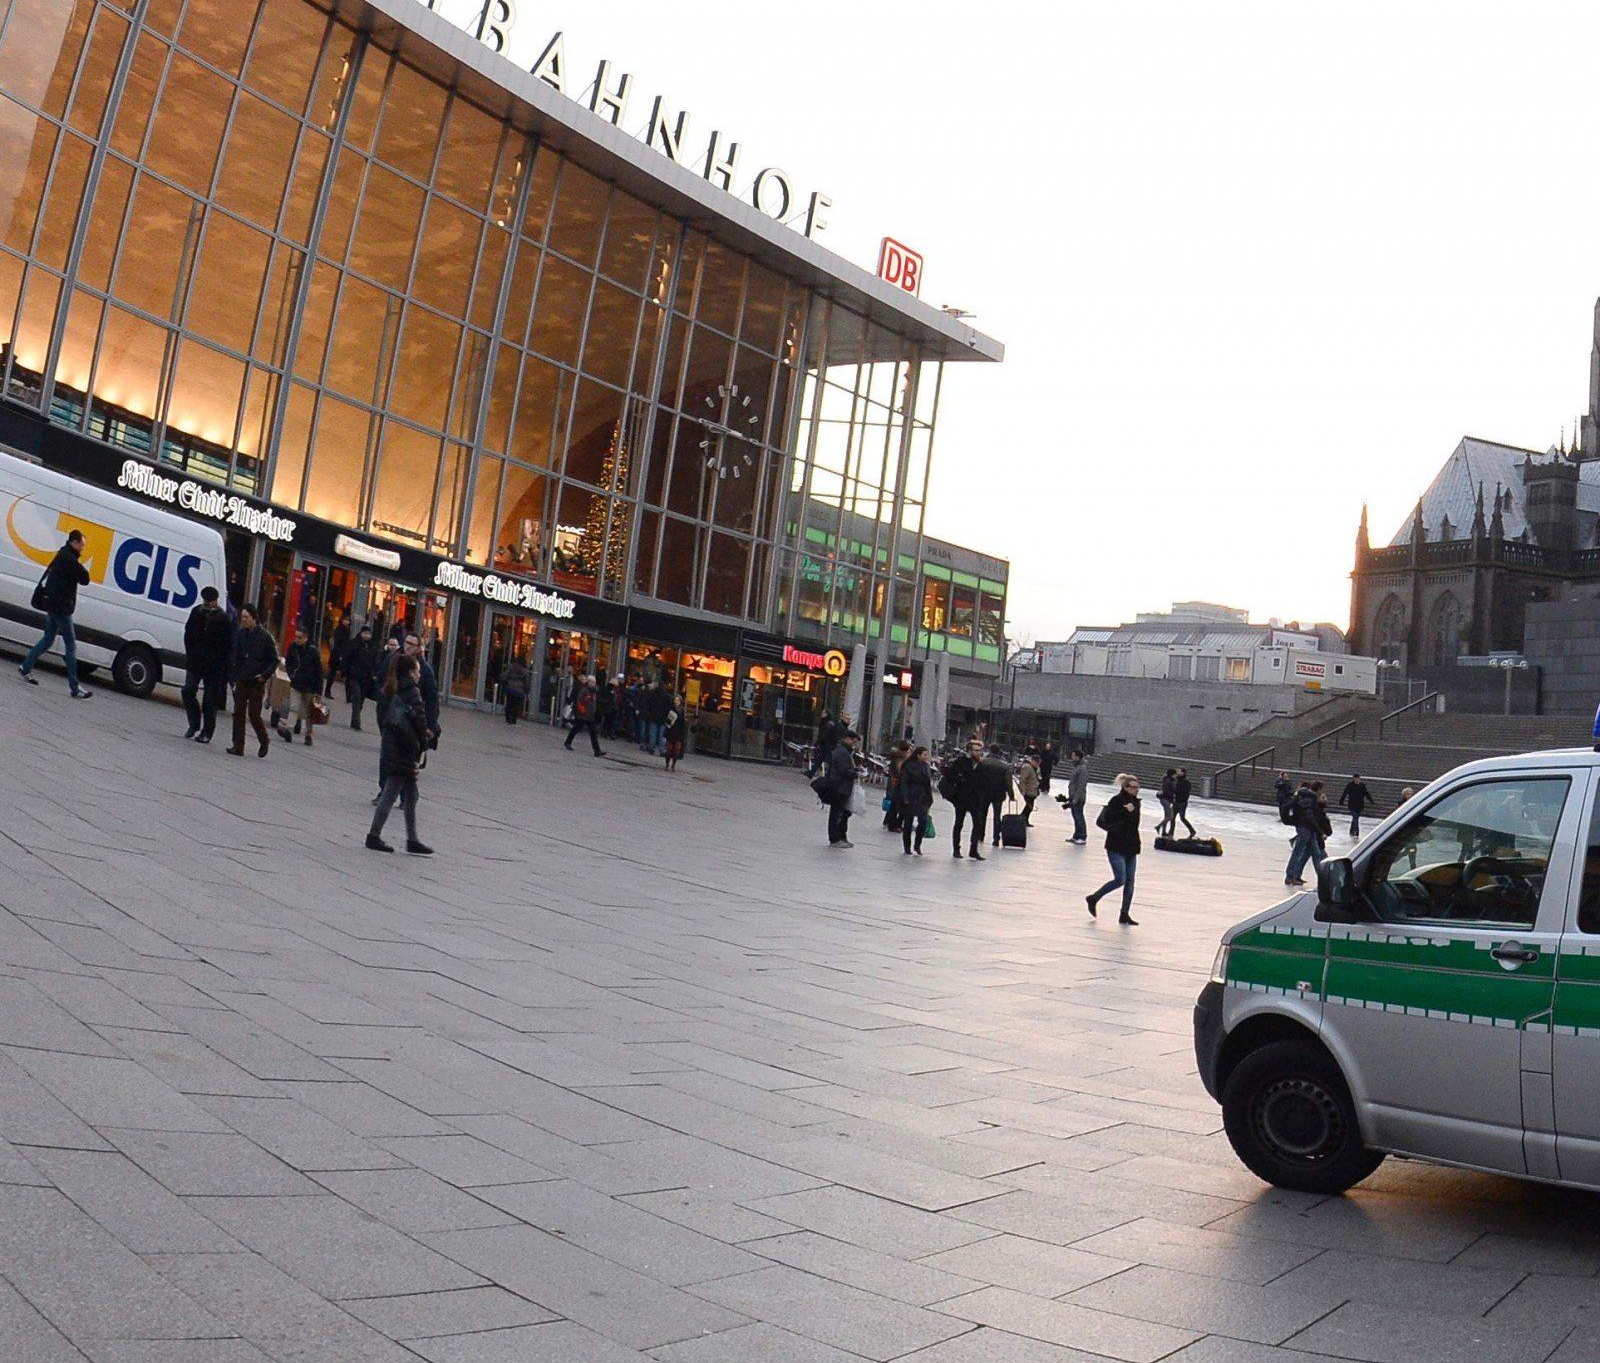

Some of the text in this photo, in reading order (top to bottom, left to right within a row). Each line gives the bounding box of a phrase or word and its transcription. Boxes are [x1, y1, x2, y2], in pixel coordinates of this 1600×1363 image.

[885, 247, 917, 292] DB
[118, 459, 178, 503] Kölner
[113, 537, 201, 609] GLS
[434, 561, 482, 595] Kölner
[783, 645, 825, 670] Kamps
[1296, 664, 1325, 675] STRABAG
